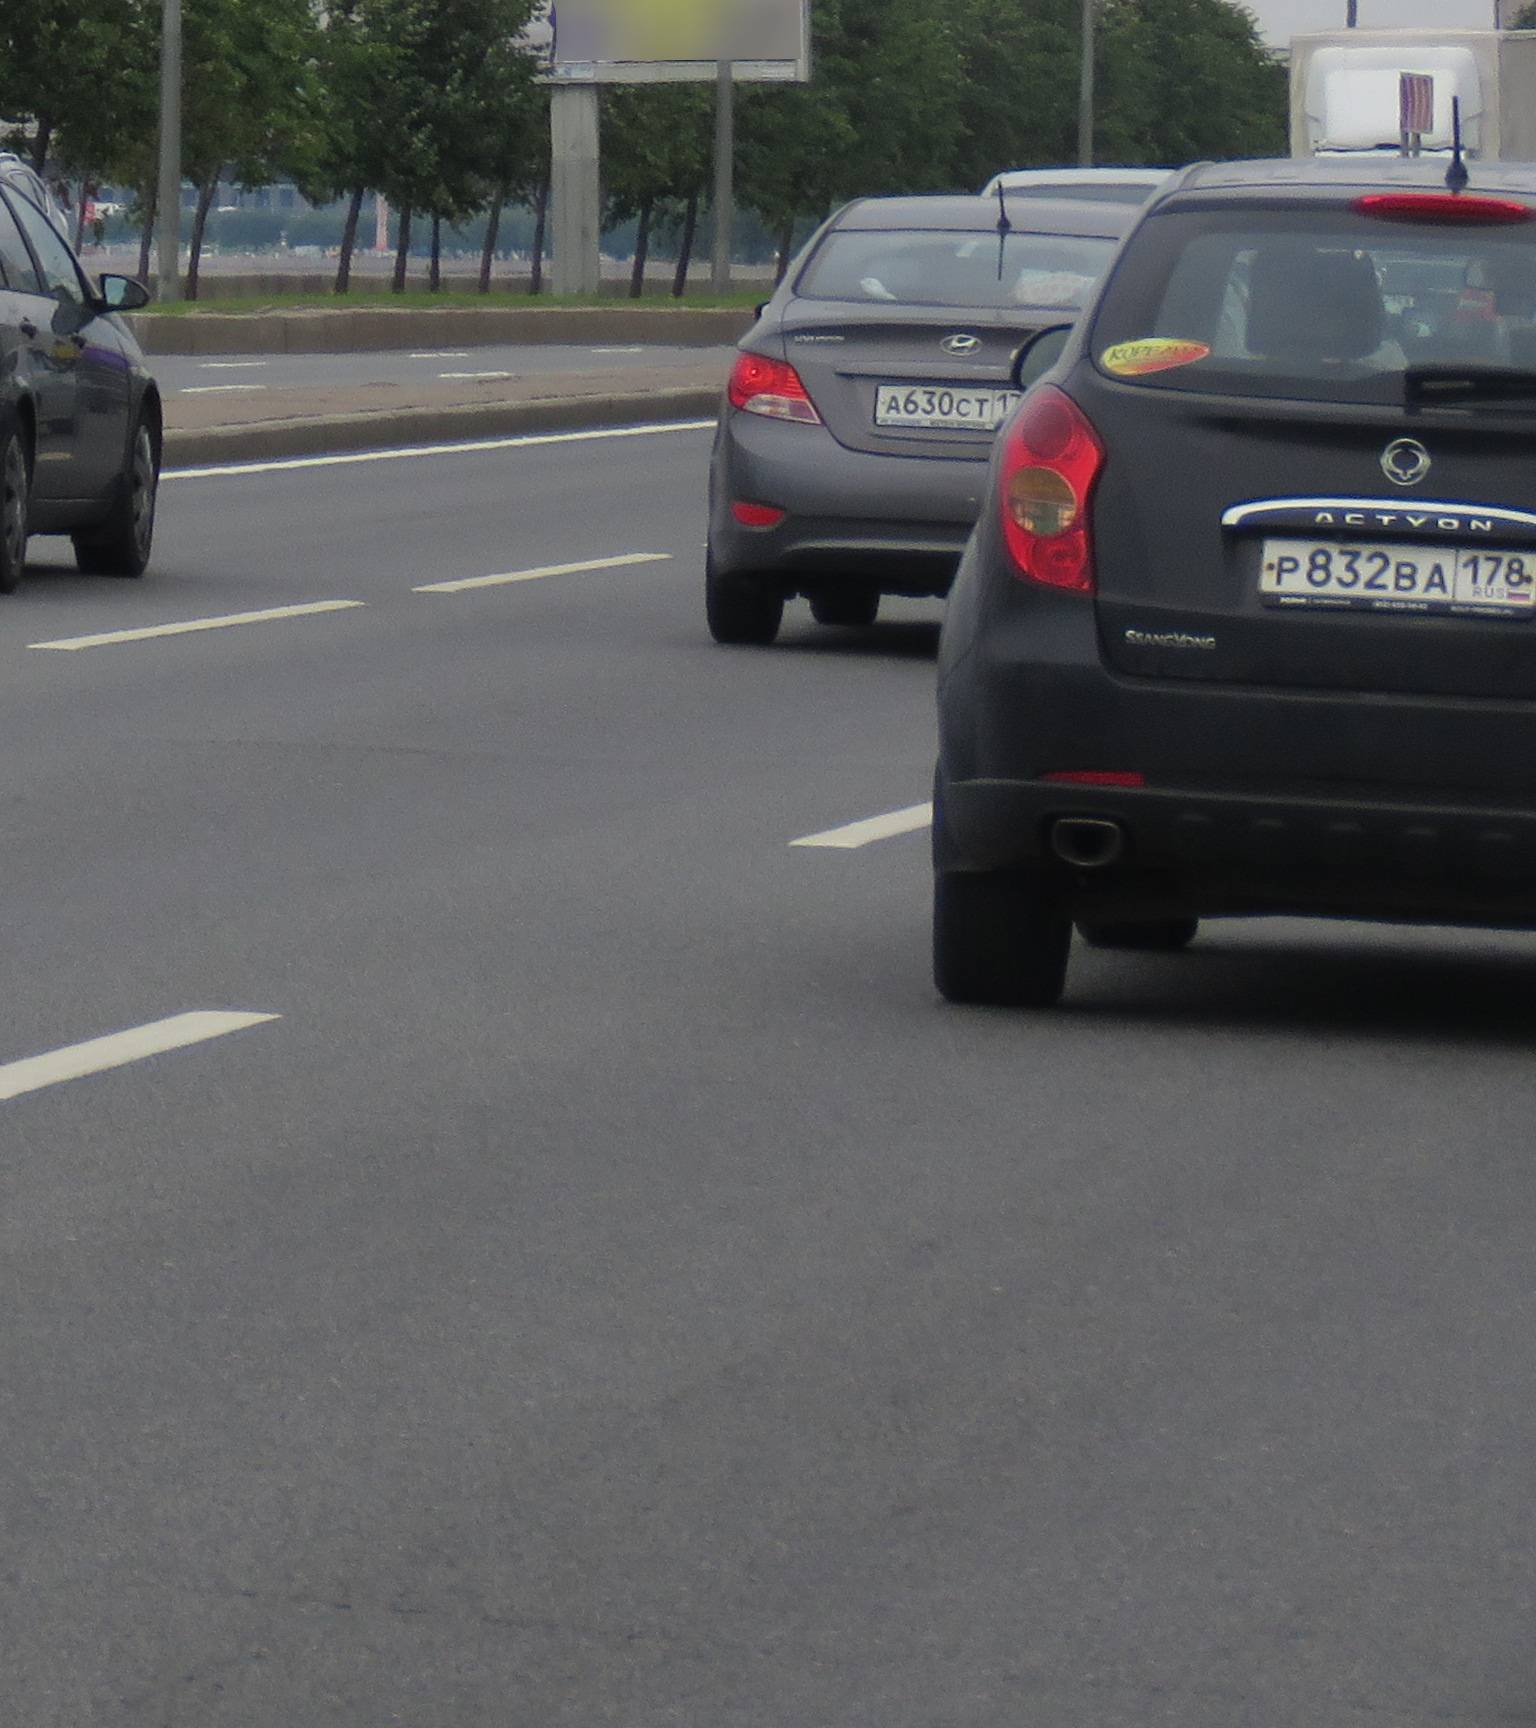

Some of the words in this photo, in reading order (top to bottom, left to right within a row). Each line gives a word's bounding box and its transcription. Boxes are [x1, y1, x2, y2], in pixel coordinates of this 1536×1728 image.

[886, 390, 990, 417] А630СТ
[1314, 512, 1492, 531] ACTYON
[1276, 548, 1447, 594] Р832ВА
[1462, 555, 1525, 587] 178
[1472, 586, 1505, 598] RUS
